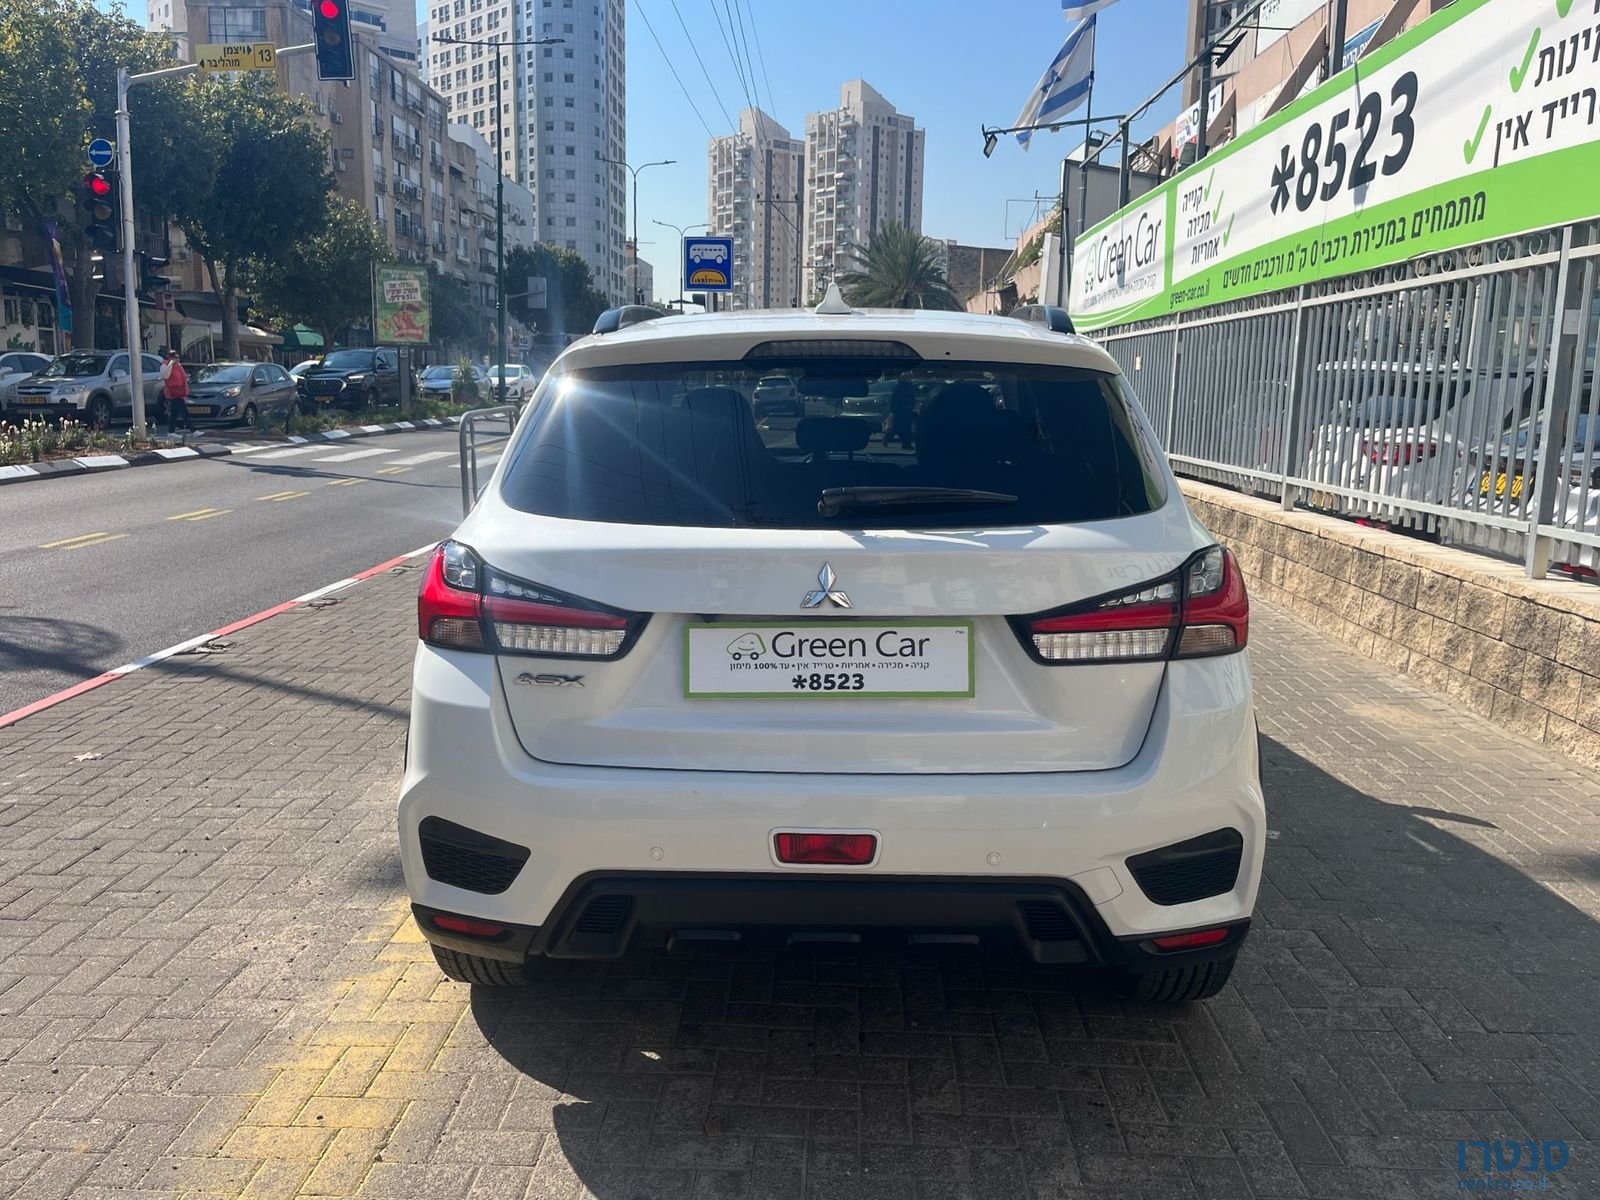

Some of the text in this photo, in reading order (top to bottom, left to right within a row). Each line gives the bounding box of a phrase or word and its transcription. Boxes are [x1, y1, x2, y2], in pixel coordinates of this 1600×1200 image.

[206, 56, 240, 68] מוהליבר
[223, 46, 246, 57] ויצמן
[258, 49, 272, 62] 13
[1493, 87, 1600, 169] רייד אין
[1182, 185, 1203, 213] קנייה
[1187, 210, 1211, 238] מכירה
[1411, 190, 1486, 239] מתמחים
[1098, 211, 1162, 284] Green Car
[1191, 236, 1220, 265] אחריות
[1322, 235, 1348, 264] רכבי
[1350, 216, 1406, 257] במכירת
[1253, 254, 1285, 281] ורכבים
[1310, 240, 1319, 267] 0
[1222, 264, 1251, 289] חדשים
[1169, 277, 1211, 310] green-car.co.il
[771, 630, 931, 658] Green Car
[513, 672, 586, 688] ASX
[730, 661, 930, 672] קניה מכירה אחריות טרייד אין עד 100% מימון
